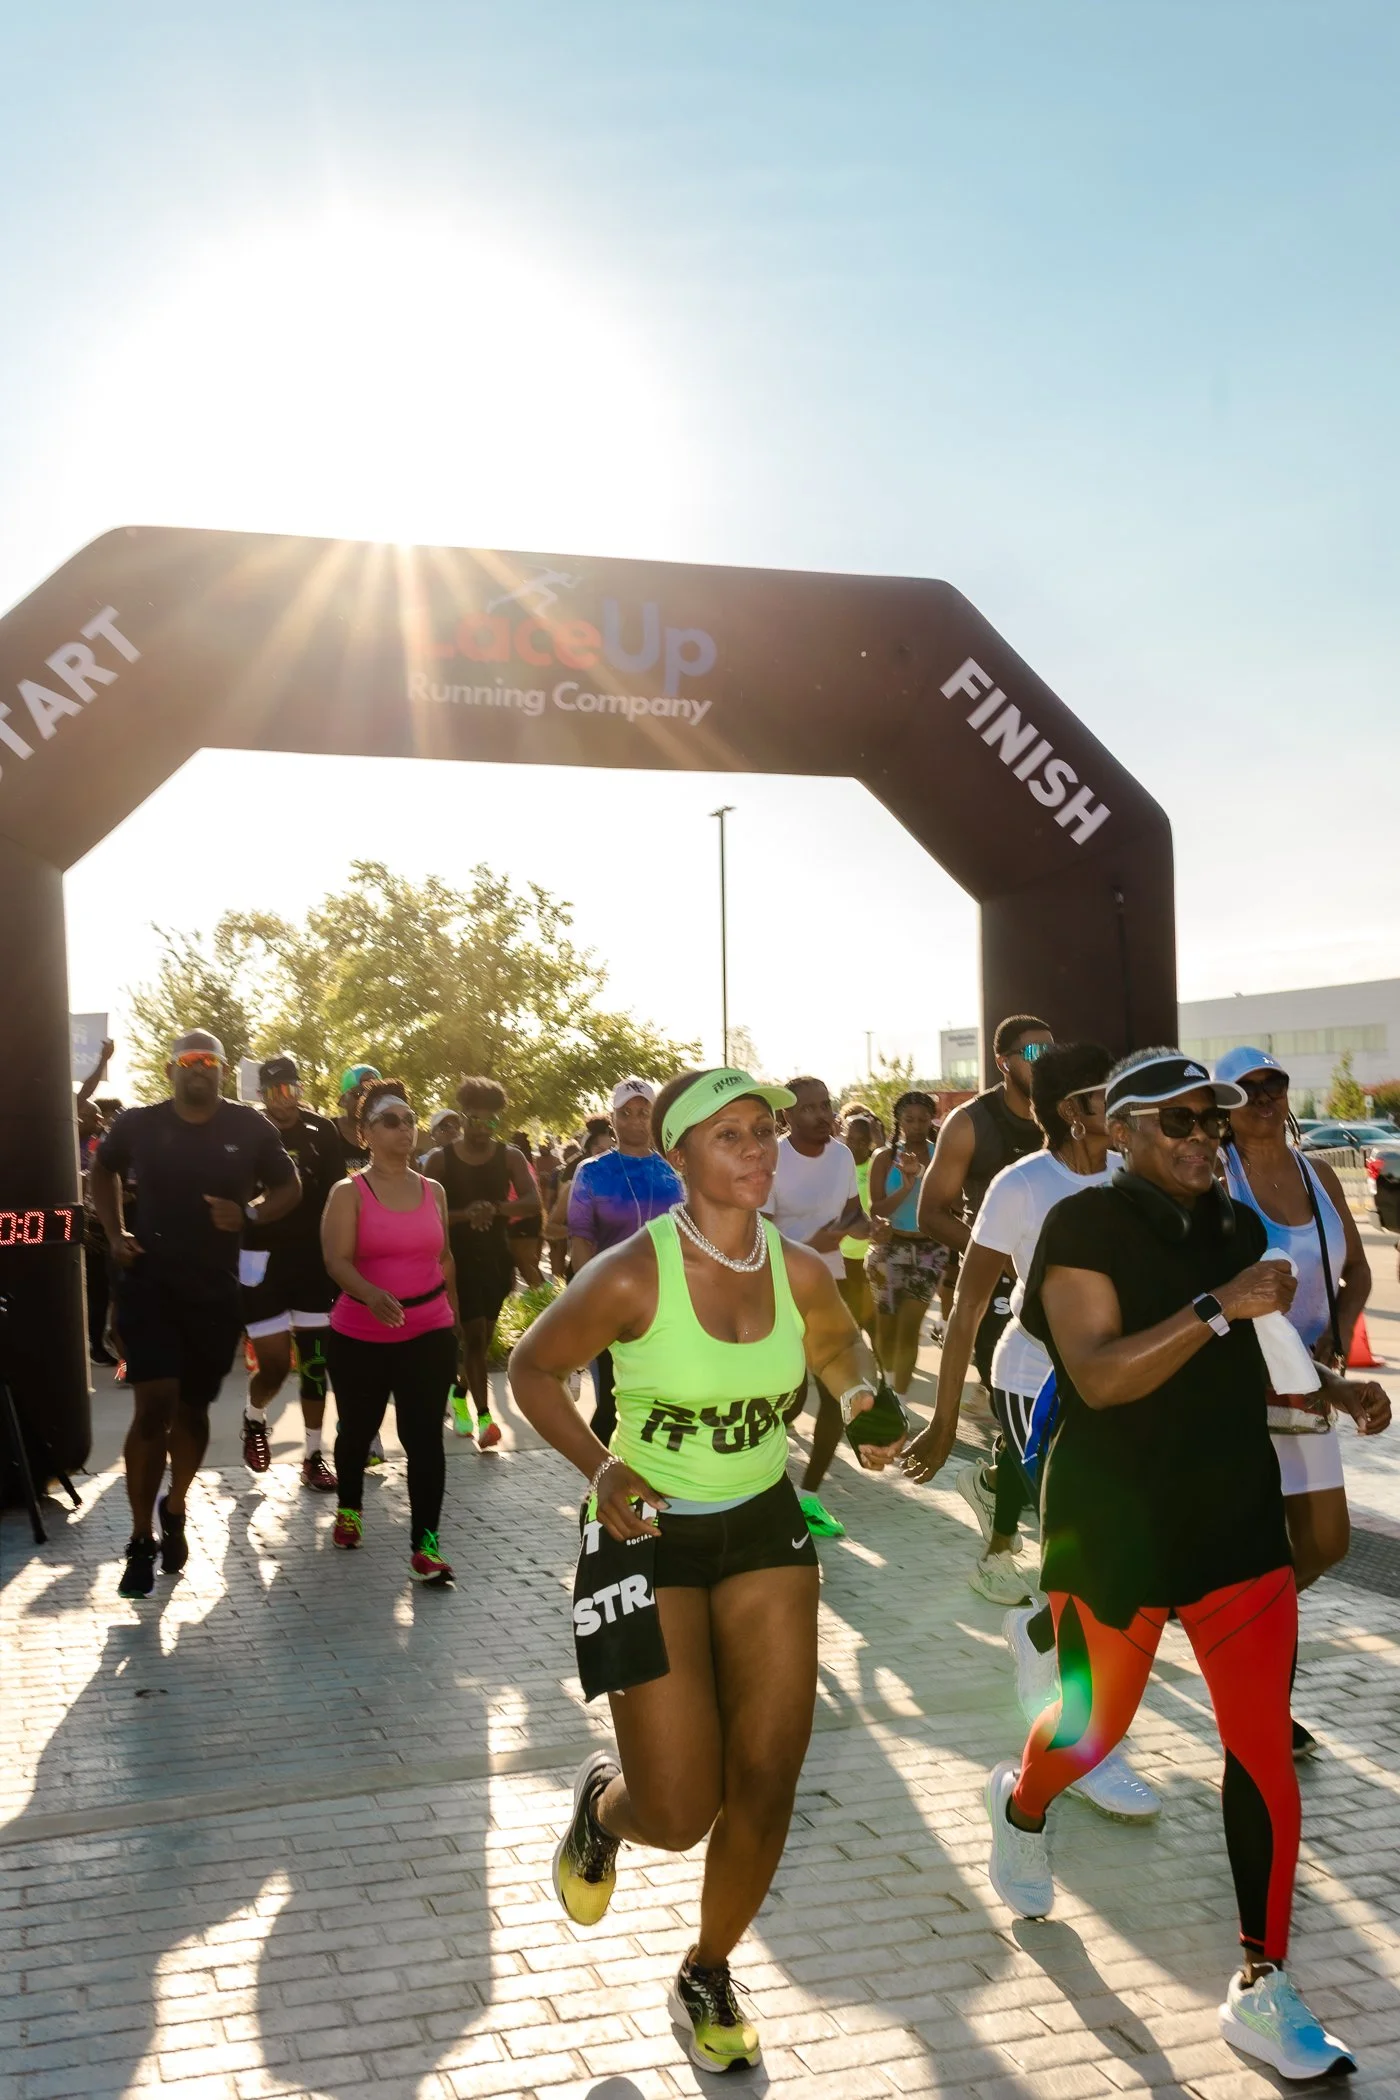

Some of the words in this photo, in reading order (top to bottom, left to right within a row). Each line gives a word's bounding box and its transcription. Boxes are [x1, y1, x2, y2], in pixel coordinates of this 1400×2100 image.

[0, 604, 143, 783] TART
[408, 671, 545, 716] Running
[552, 681, 713, 726] Company
[939, 656, 1112, 845] FINISH
[640, 1419, 699, 1452] IT
[573, 1573, 656, 1637] STR
